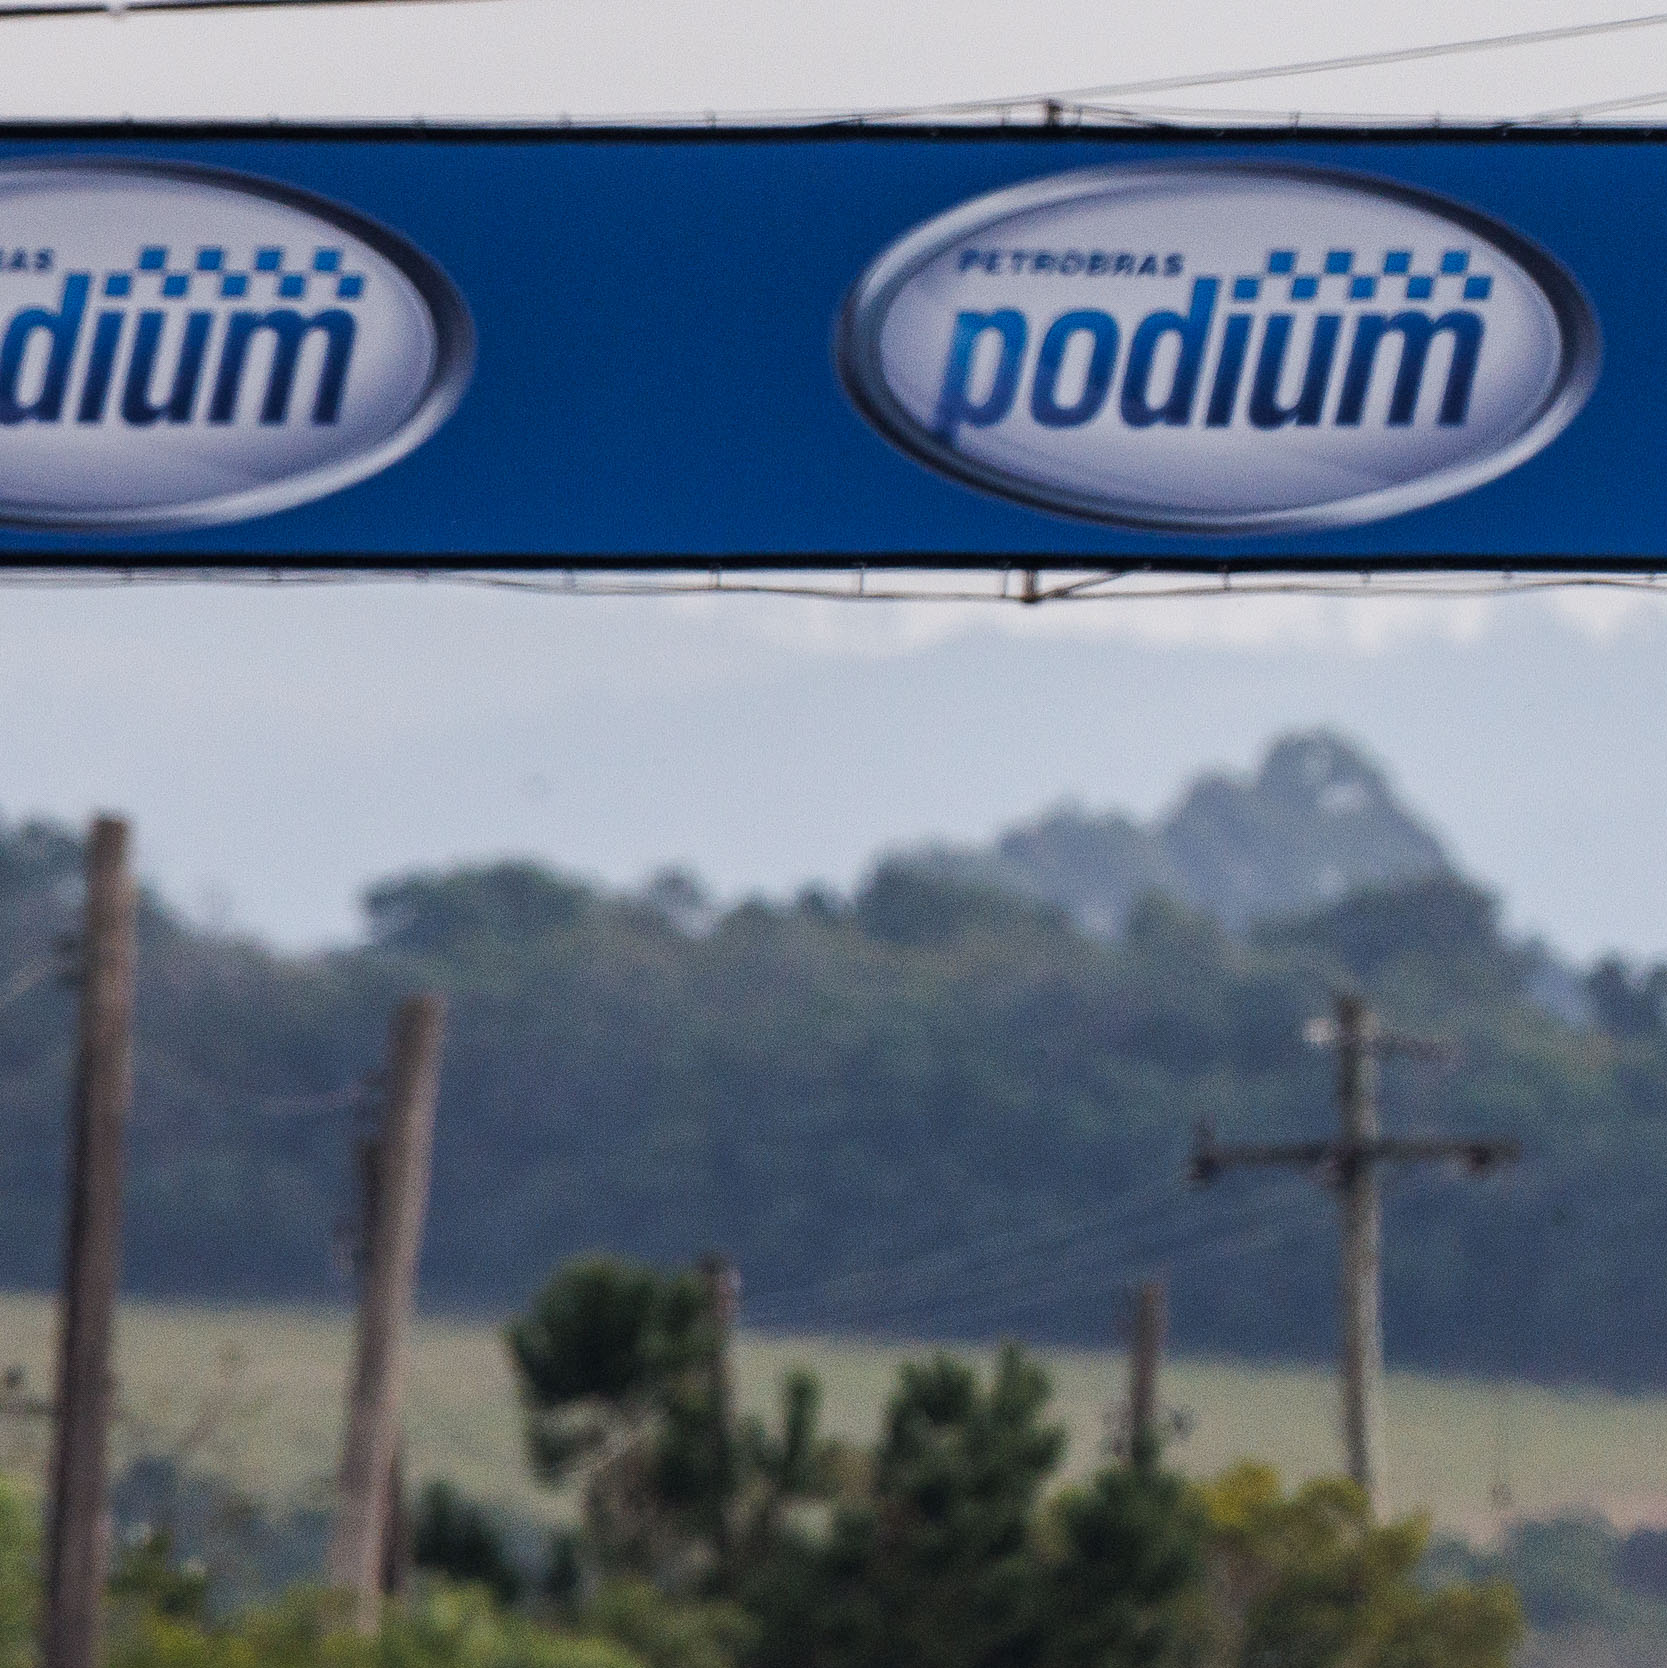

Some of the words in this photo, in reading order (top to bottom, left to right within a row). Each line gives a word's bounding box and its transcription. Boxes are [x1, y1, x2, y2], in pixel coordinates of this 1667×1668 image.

[958, 248, 1184, 277] PETROBRAS
[0, 272, 358, 426] dium
[935, 275, 1485, 445] podium
